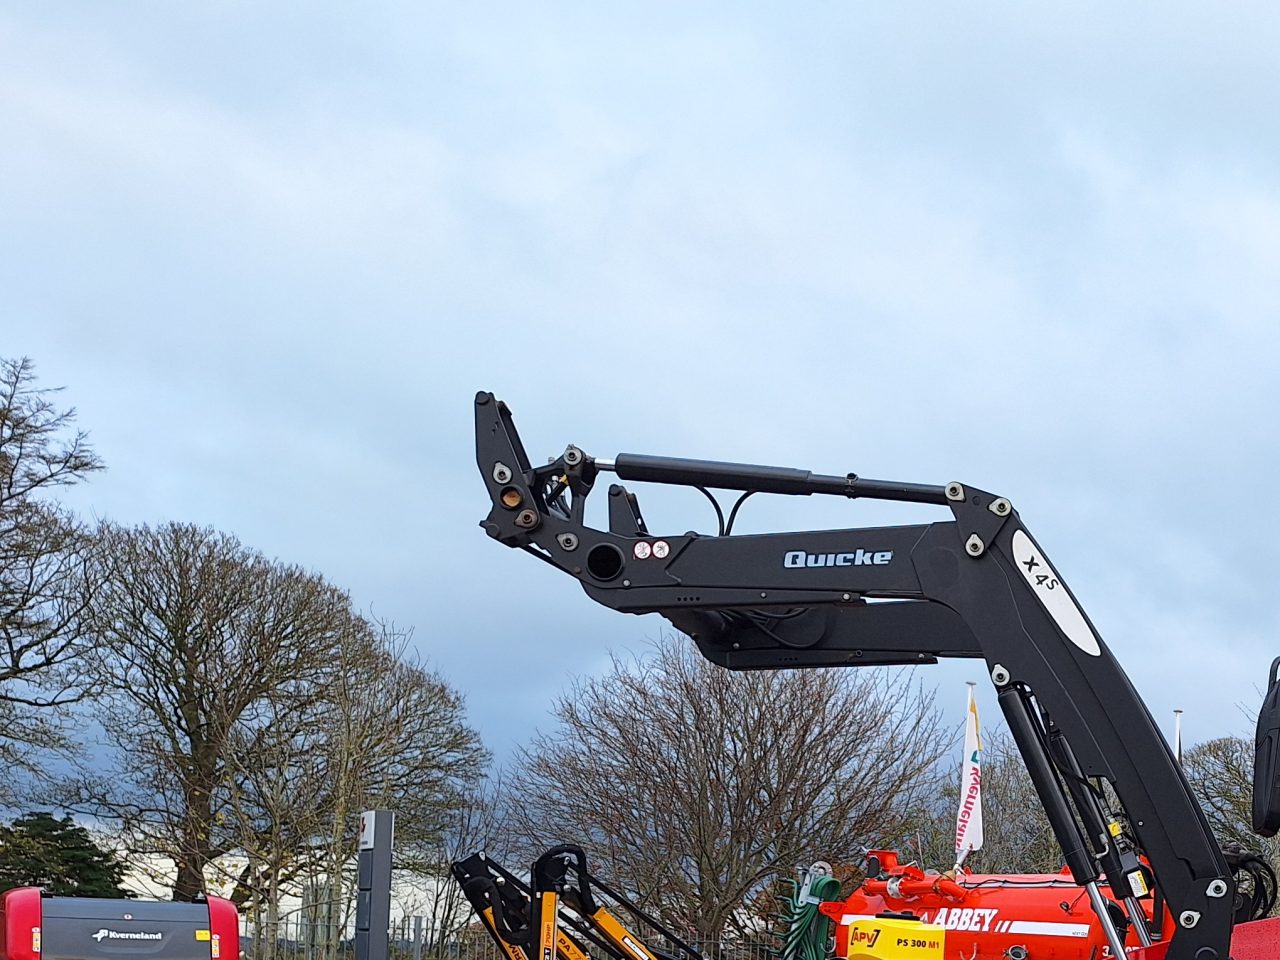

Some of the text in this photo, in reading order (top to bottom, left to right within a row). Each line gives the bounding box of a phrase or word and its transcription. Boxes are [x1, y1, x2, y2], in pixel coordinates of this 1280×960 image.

[784, 549, 892, 568] Quicke
[933, 907, 999, 932] ABBEY
[109, 931, 162, 940] Kverneland
[897, 938, 940, 949] PS 300 M1
